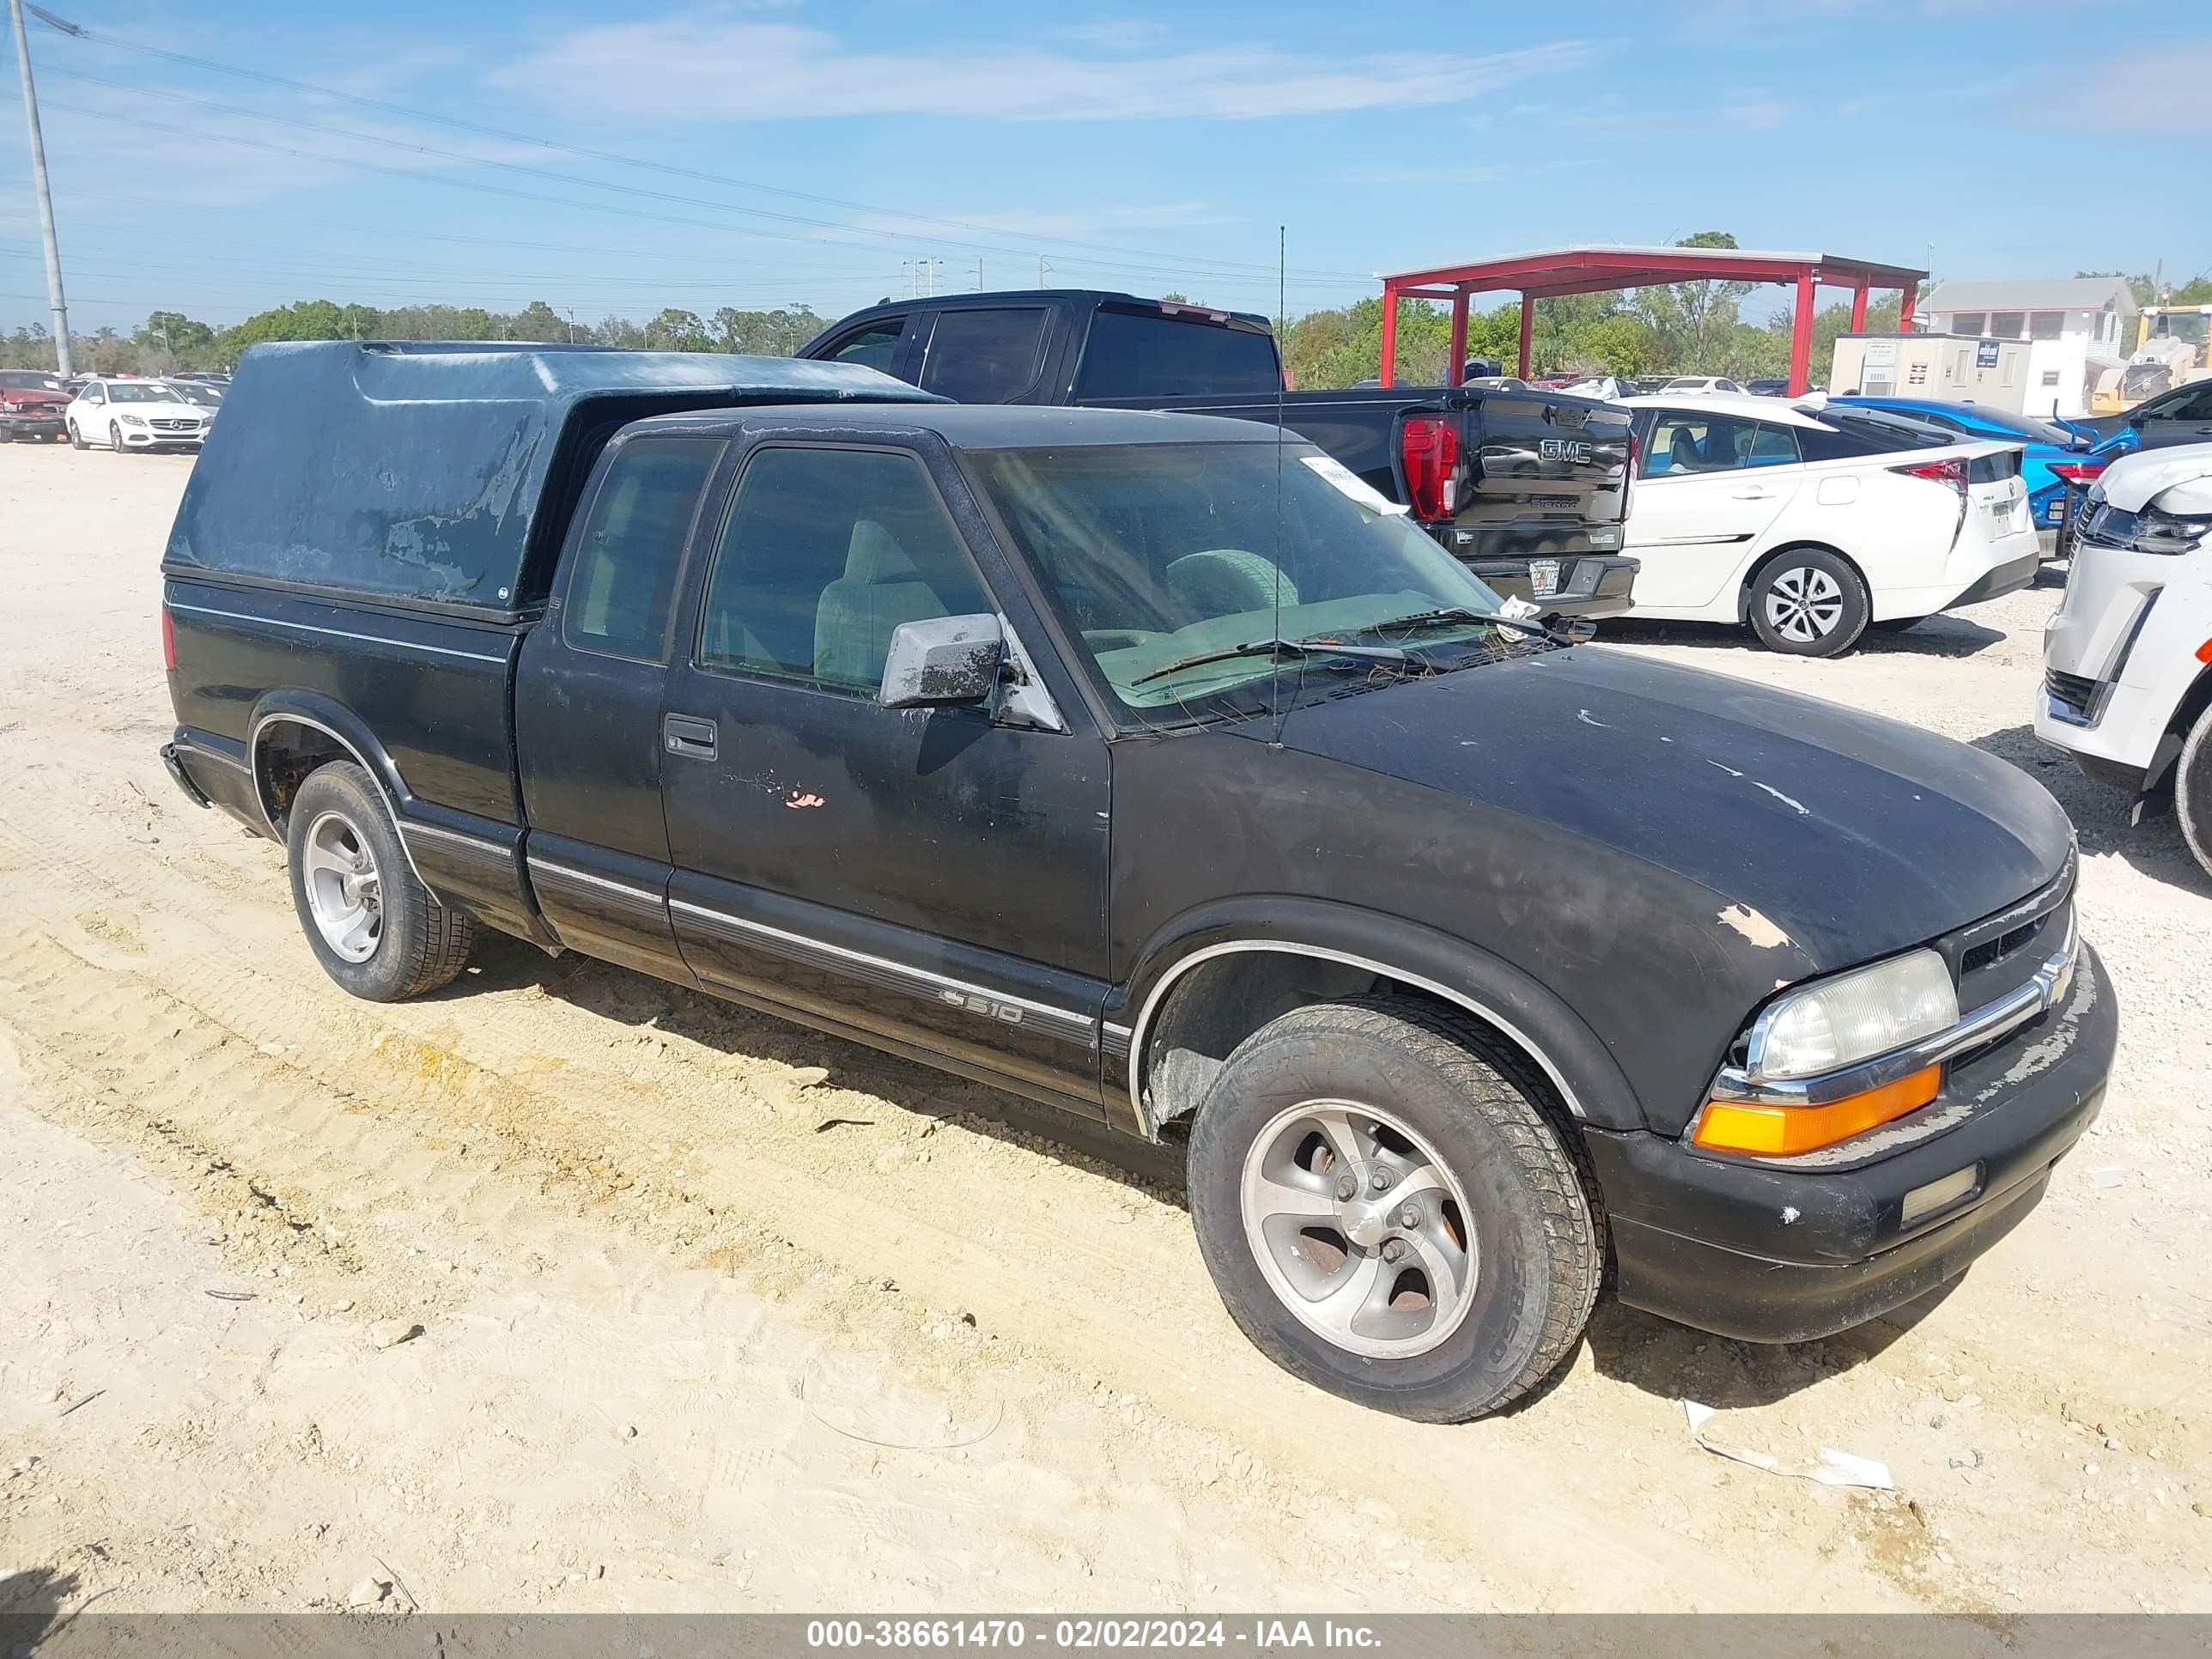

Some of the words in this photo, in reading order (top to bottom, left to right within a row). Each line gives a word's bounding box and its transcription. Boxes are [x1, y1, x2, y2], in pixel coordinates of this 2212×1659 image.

[1540, 440, 1592, 465] GMC
[1530, 499, 1579, 509] SIERRA
[967, 996, 1024, 1024] S10
